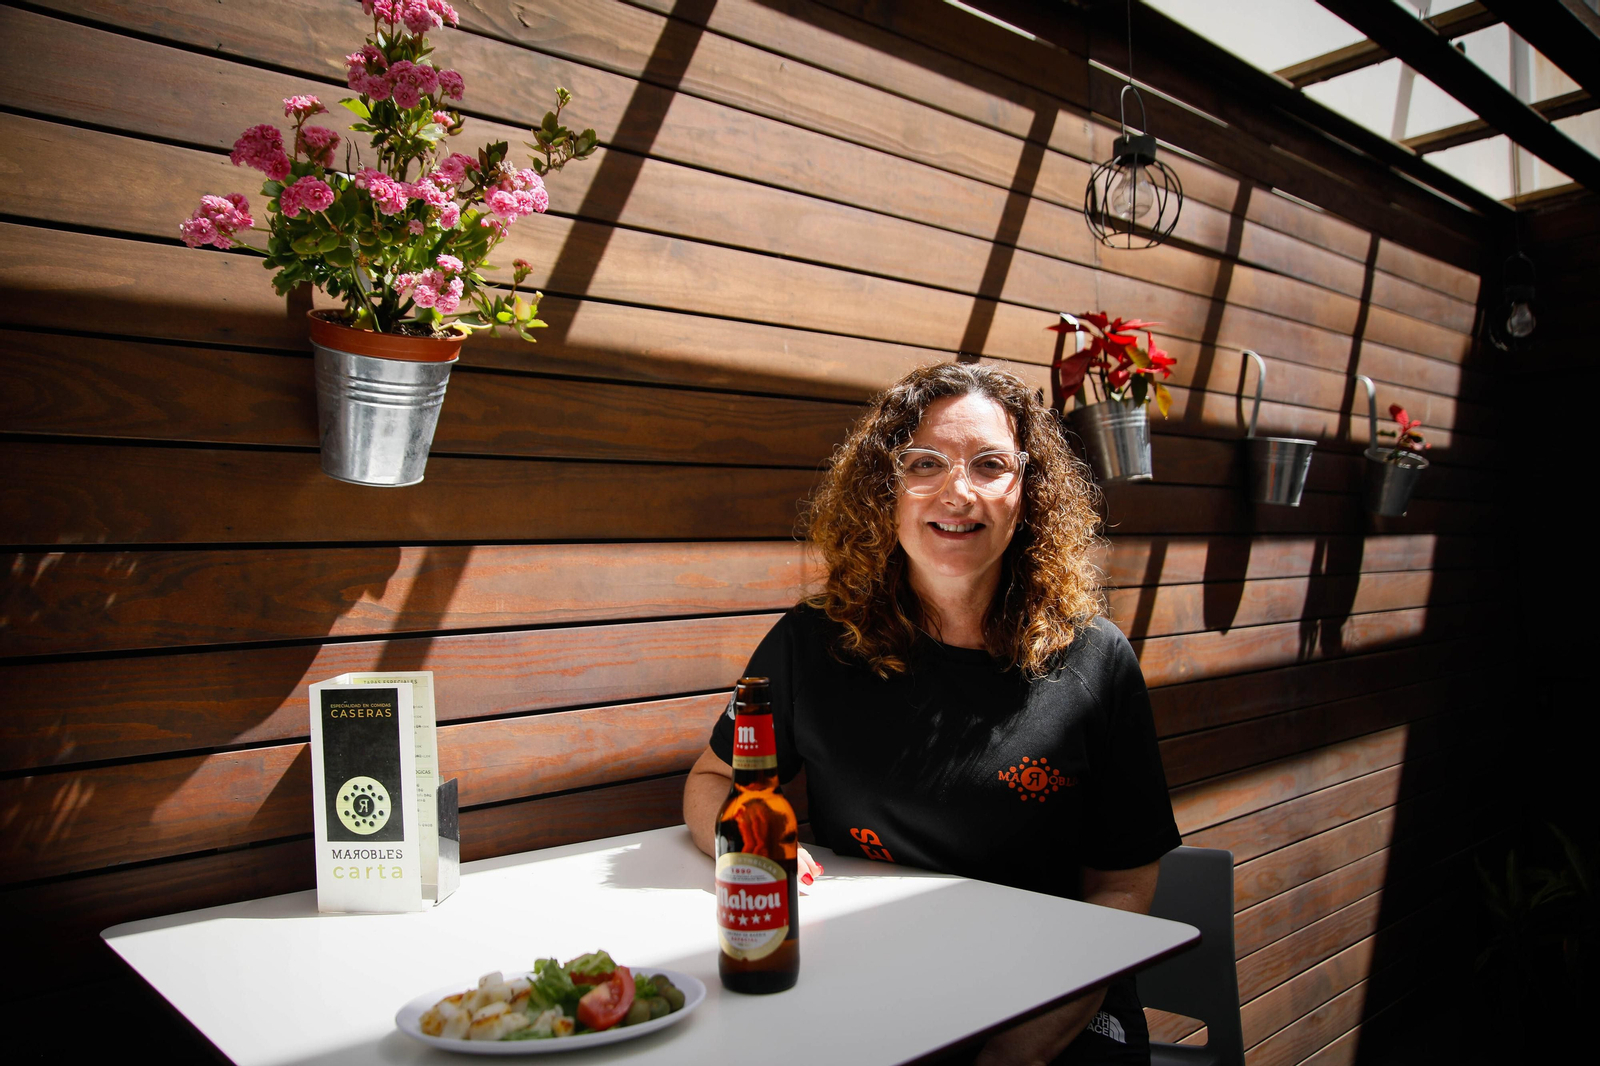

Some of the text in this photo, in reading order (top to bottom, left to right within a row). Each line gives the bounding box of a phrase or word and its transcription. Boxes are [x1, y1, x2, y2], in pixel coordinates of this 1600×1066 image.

[330, 708, 392, 719] CASERAS
[333, 864, 403, 879] carta
[717, 884, 782, 911] Mahou
[1086, 1022, 1109, 1037] ACE
